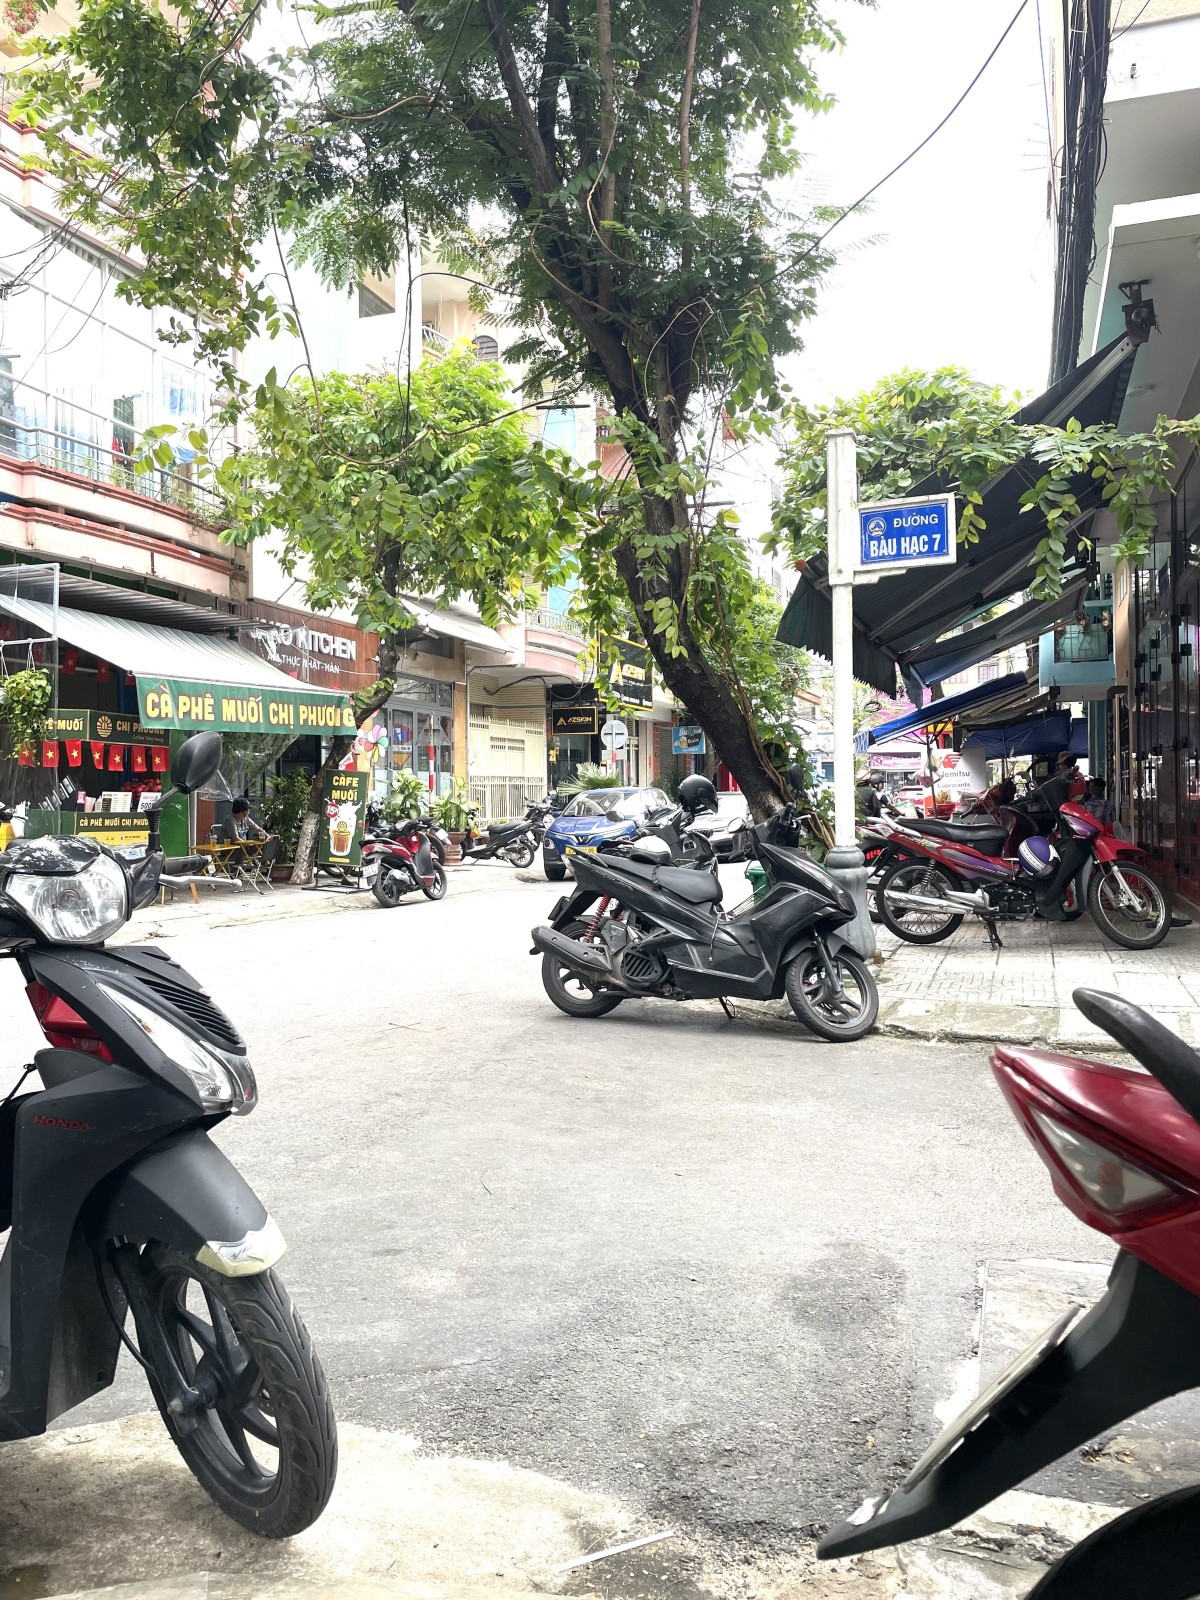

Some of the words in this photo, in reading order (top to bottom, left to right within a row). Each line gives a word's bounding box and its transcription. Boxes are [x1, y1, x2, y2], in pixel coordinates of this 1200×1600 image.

[893, 512, 939, 528] ĐƯỜNG
[869, 536, 897, 558] BÀU
[900, 534, 929, 556] HẠC
[931, 533, 942, 552] 7
[297, 626, 357, 660] KITCHEN
[146, 684, 173, 718] CÀ
[178, 693, 215, 721] PHÊ
[222, 696, 264, 723] MUỐI
[269, 702, 294, 730] CHỊ
[57, 717, 84, 731] MUỐI
[116, 720, 130, 734] CHỊ
[332, 773, 359, 787] CÀFE
[331, 788, 358, 801] MUỐI
[90, 817, 103, 827] PHÊ
[104, 816, 120, 827] MUỐI
[121, 818, 132, 828] CHỊ
[32, 1115, 91, 1130] HONDA
